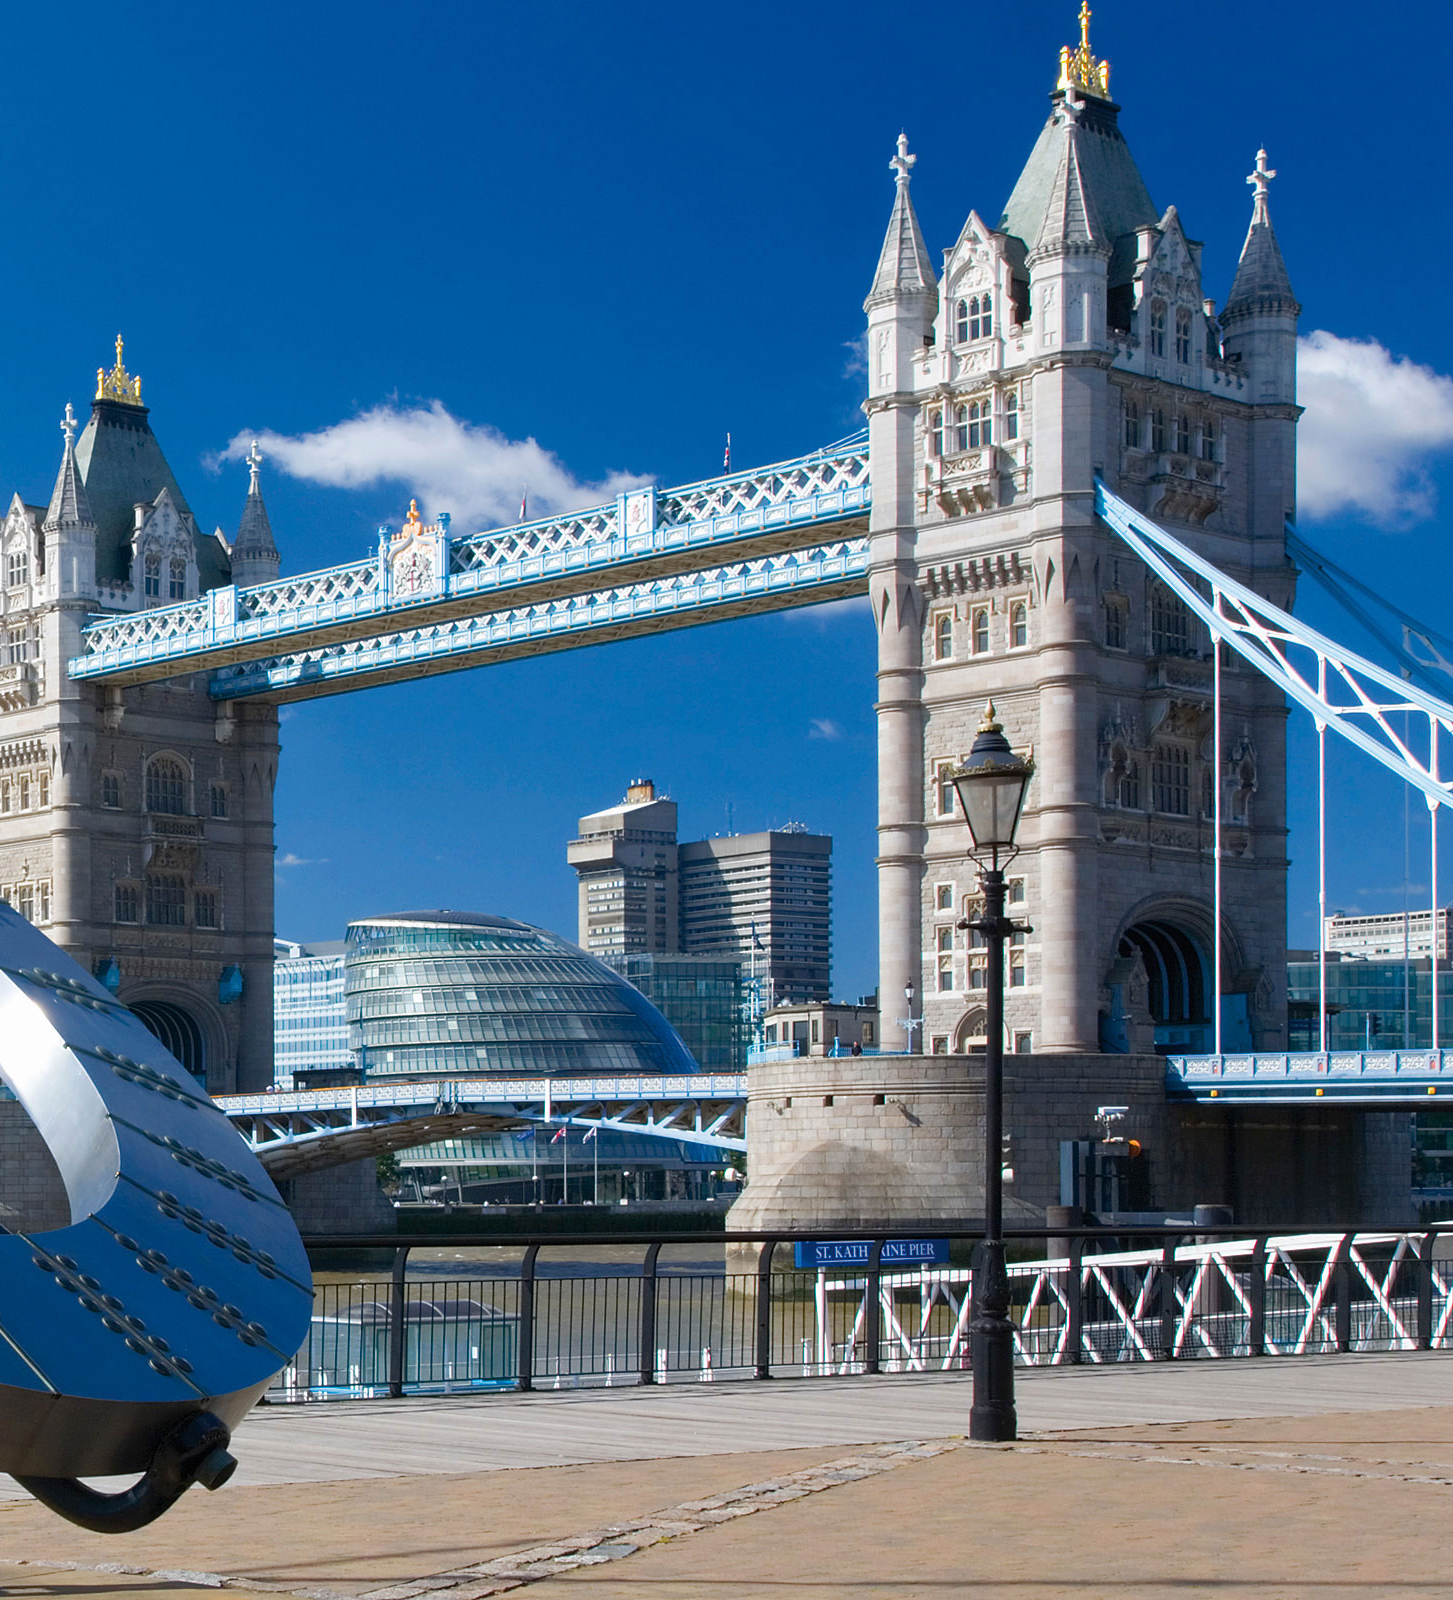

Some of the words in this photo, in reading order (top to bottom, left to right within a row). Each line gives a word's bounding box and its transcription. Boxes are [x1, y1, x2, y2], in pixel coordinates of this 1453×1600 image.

[815, 1246, 832, 1259] ST.
[835, 1243, 907, 1259] KATHRINE
[909, 1243, 935, 1256] PIER
